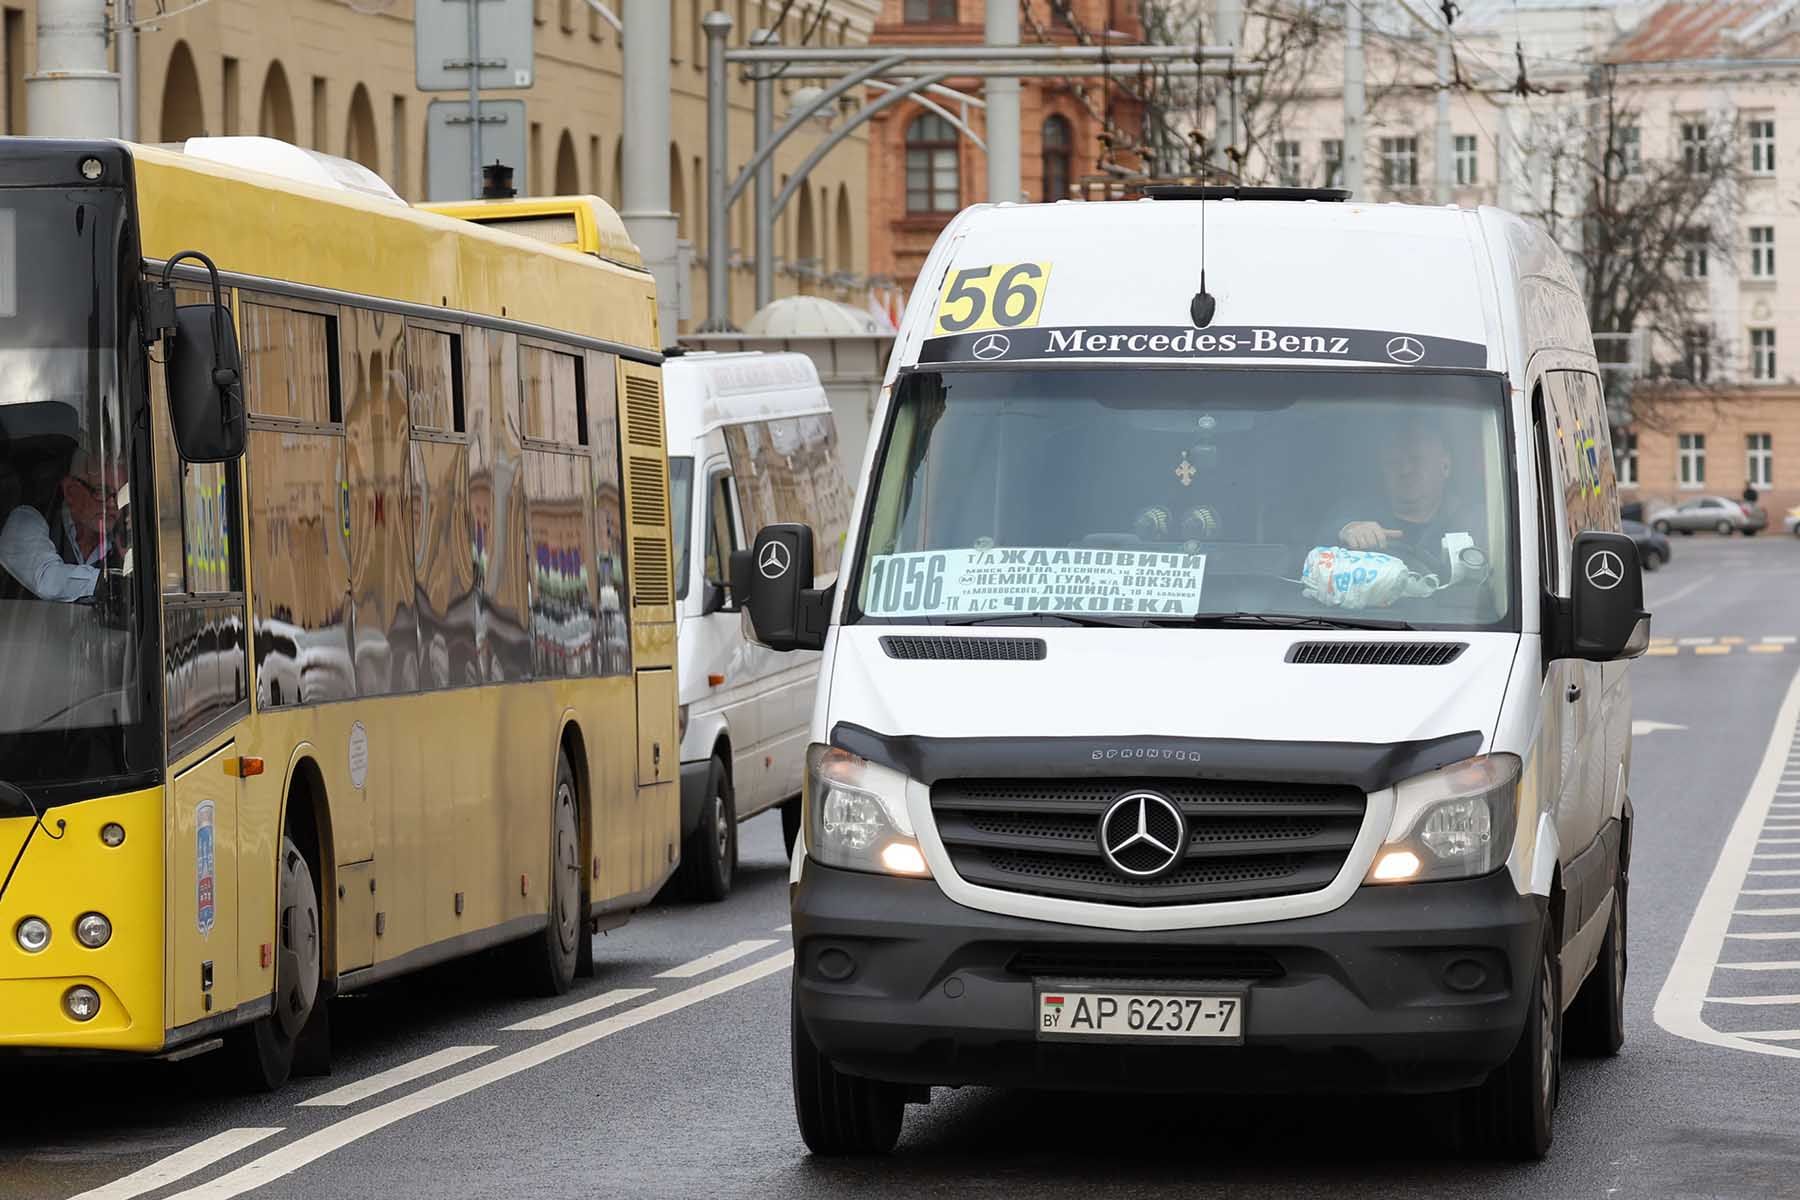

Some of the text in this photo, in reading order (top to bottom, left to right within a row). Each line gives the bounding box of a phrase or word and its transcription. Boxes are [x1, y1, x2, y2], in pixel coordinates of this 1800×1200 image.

[939, 262, 1042, 332] 56
[1044, 328, 1351, 356] Mercedes-Benz
[1001, 549, 1201, 569] ЖДАНОВИЧИ
[1122, 575, 1196, 589] ВОКЗАЛ
[1136, 568, 1192, 577] ЗАМОК
[869, 555, 946, 613] 1056
[1004, 596, 1184, 614] ЧИЖОВКА
[1091, 748, 1201, 761] SPRINTER
[1043, 1014, 1061, 1027] BY
[1070, 997, 1237, 1032] AP 6237-7
